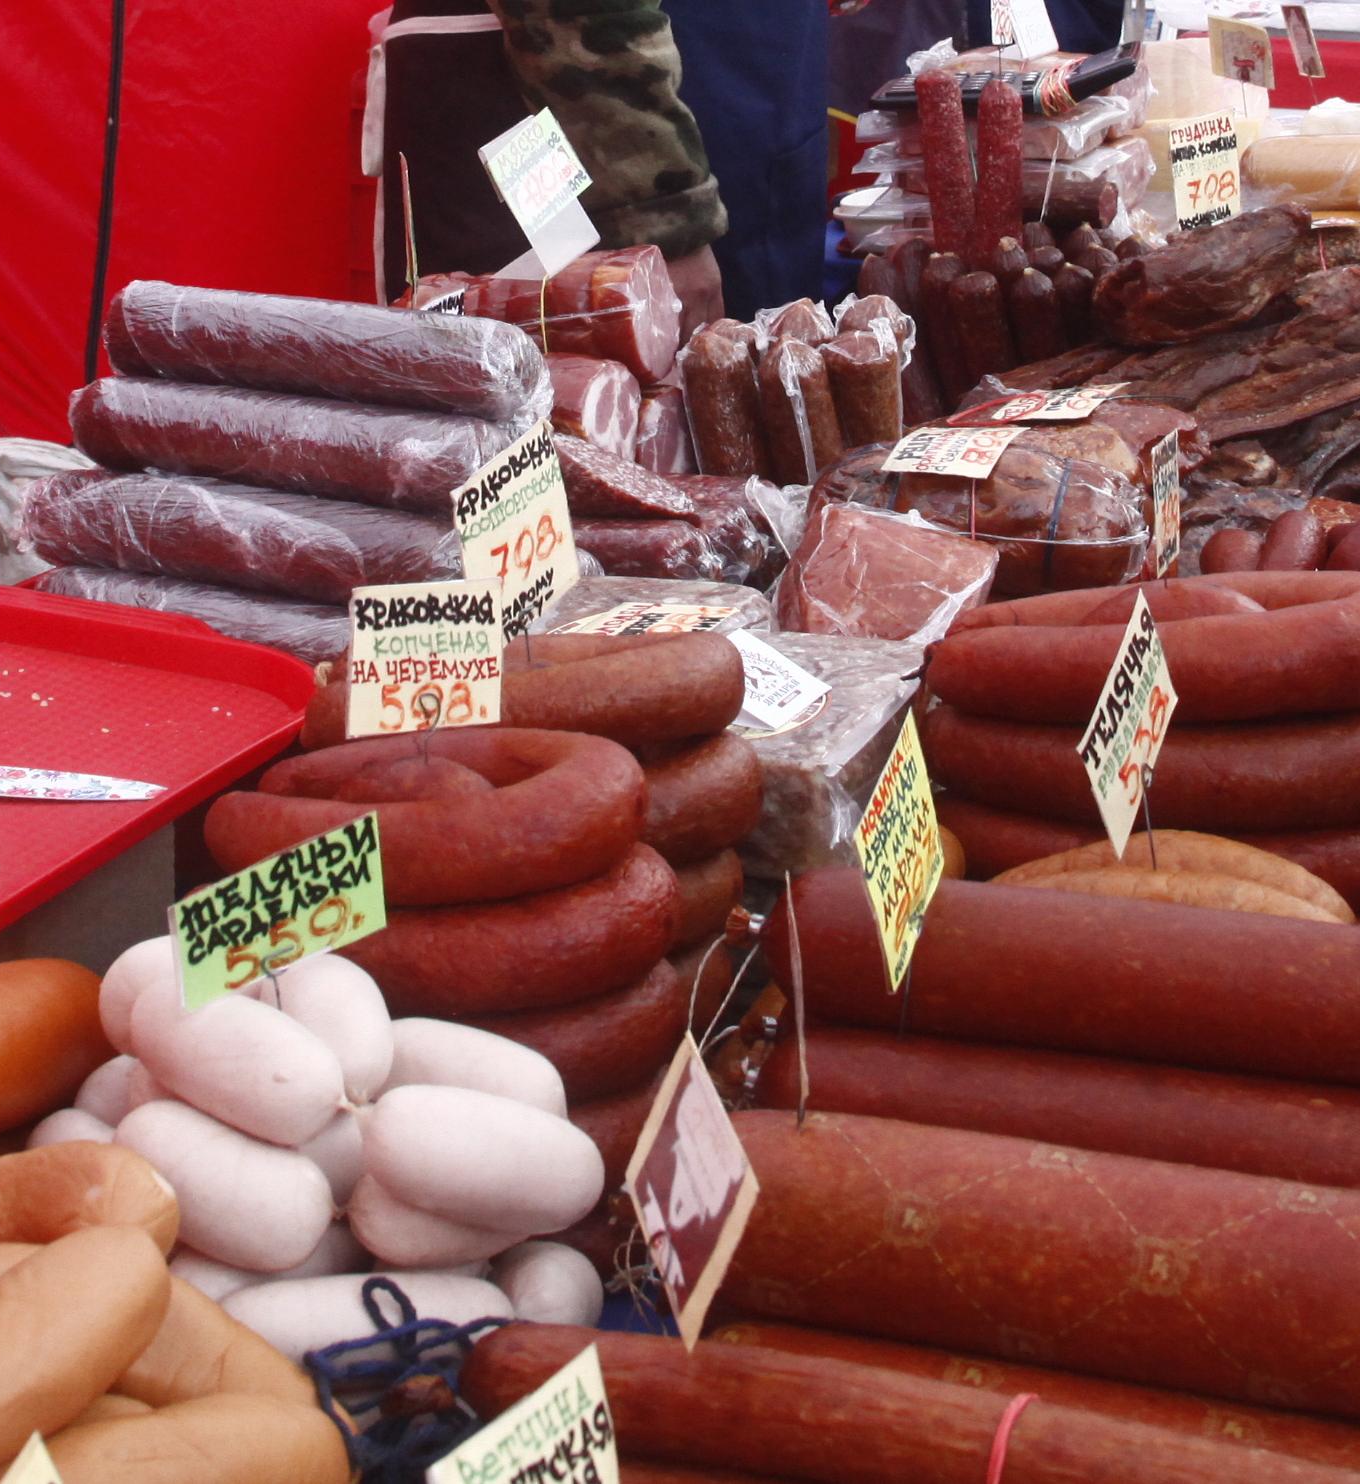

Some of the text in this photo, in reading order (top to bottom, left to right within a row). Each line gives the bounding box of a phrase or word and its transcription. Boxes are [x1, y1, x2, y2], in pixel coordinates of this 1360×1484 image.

[1170, 117, 1232, 145] ГРУДИНКА
[456, 431, 556, 525] КРАКОВСКАЯ
[355, 592, 496, 631] КРАКОВСКАЯ
[352, 652, 501, 685] НА ЧЕРЁМУХЕ
[1082, 607, 1155, 770] ТЕЛЯЧЬЯ
[187, 853, 371, 966] САРДЕЛЬКИ
